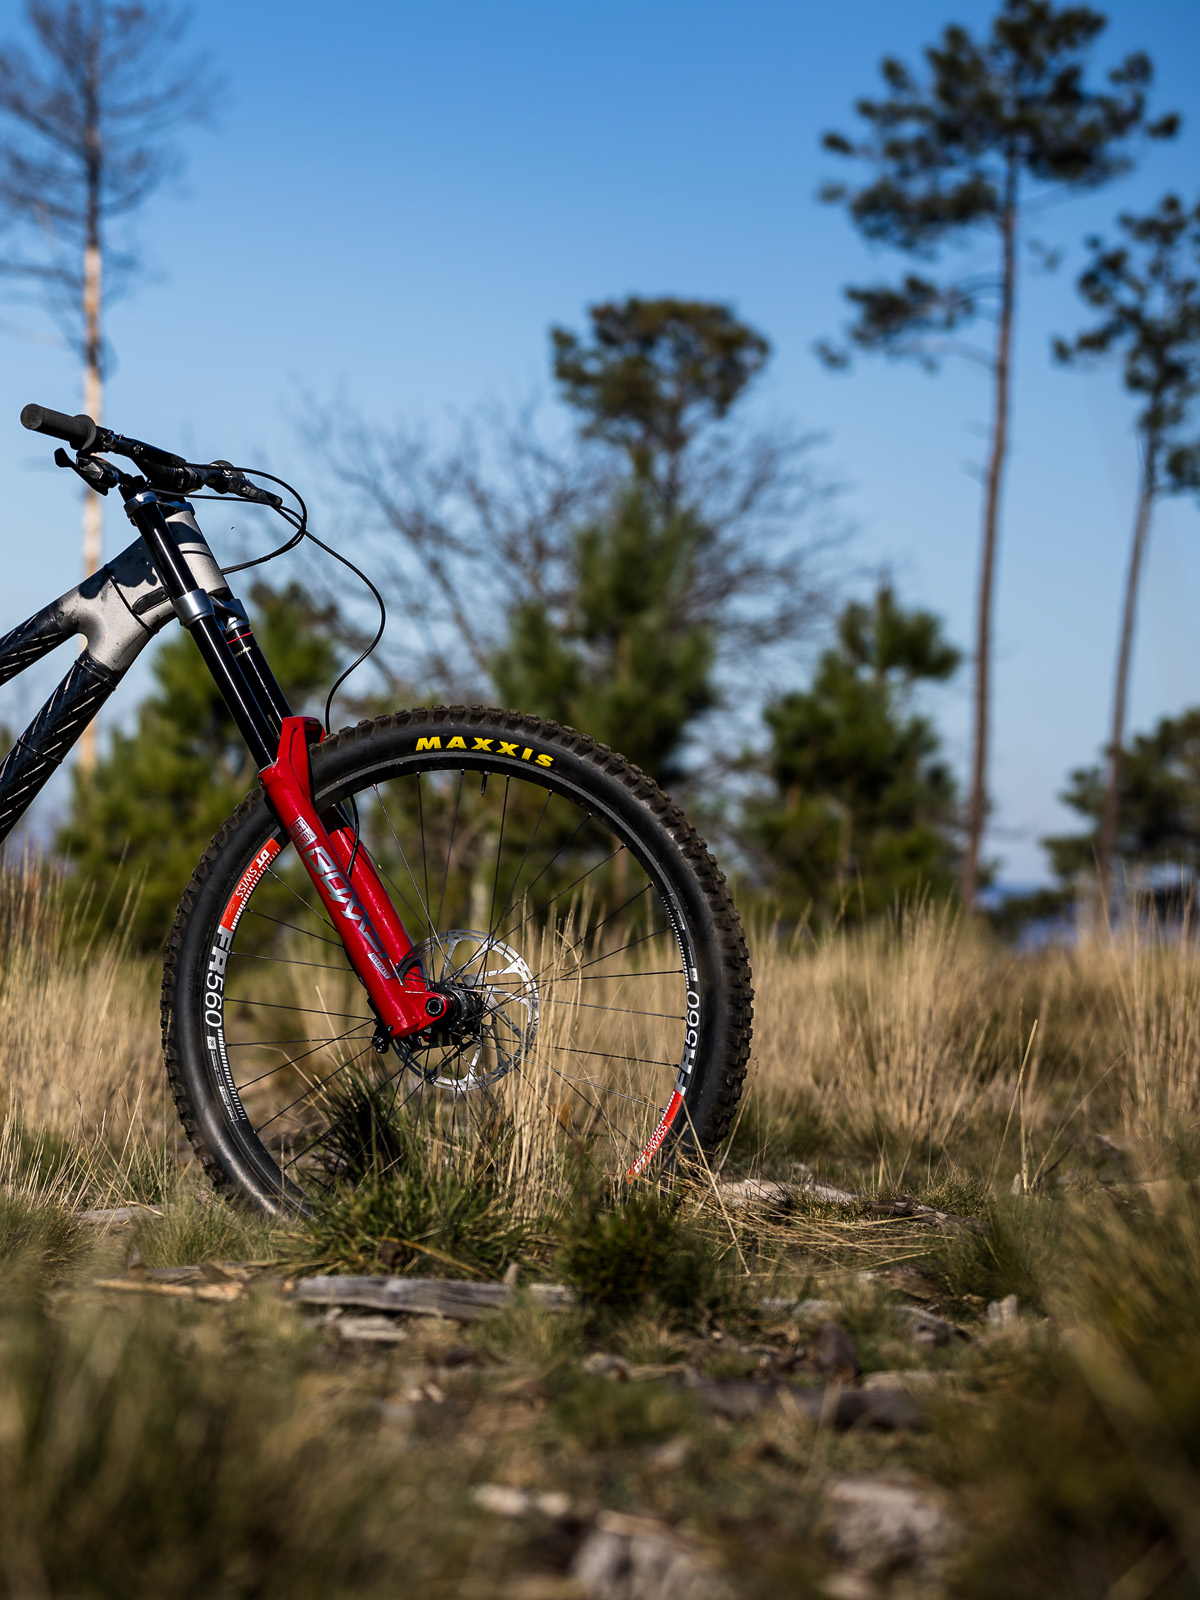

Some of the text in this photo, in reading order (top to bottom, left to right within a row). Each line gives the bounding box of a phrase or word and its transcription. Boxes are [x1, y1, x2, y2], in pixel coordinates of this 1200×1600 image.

[415, 736, 554, 767] MAXXIS
[235, 849, 270, 898] DT SWISS
[204, 924, 234, 1028] FR560
[674, 990, 700, 1097] FR560
